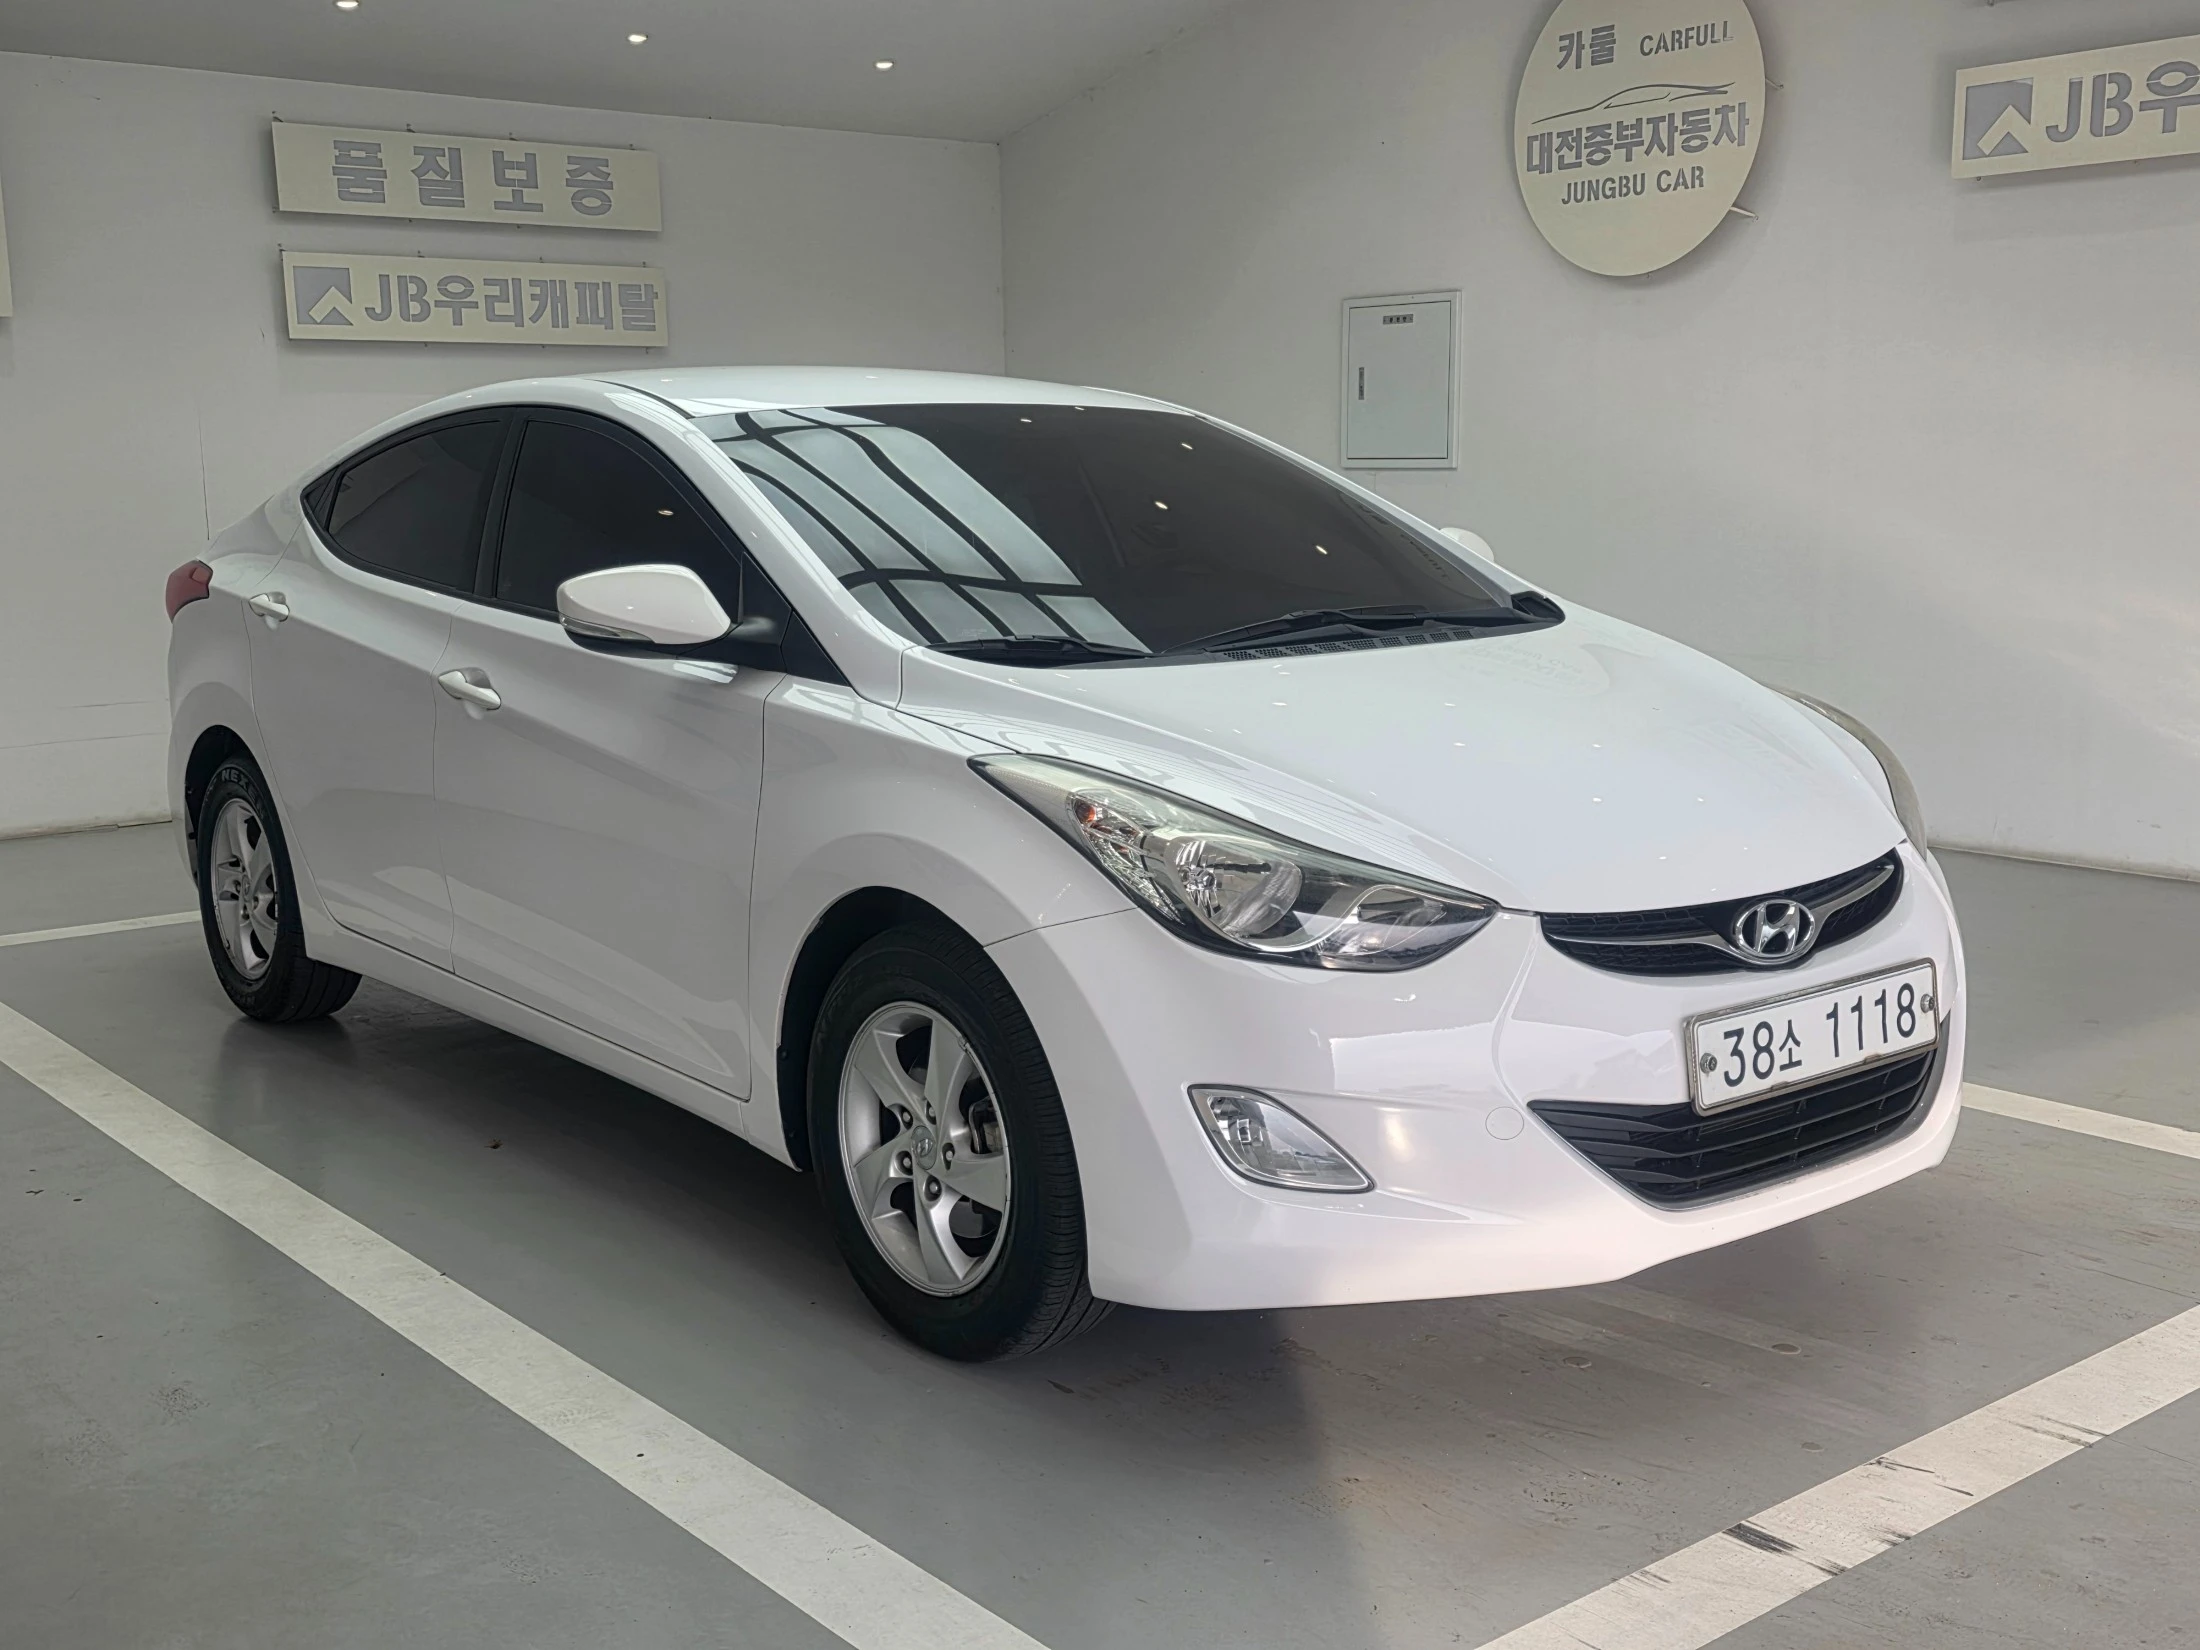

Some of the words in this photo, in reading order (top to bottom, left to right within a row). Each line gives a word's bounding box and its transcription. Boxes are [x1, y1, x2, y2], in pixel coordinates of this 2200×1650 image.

[1639, 20, 1735, 57] CARFULL
[1525, 101, 1750, 175] 대전중부자동차
[1561, 172, 1646, 205] JUNGBU
[1656, 165, 1705, 193] CAR
[364, 273, 659, 332] JB우리캐피탈
[1722, 1019, 1803, 1088] 38소
[1826, 982, 1917, 1058] 1118
